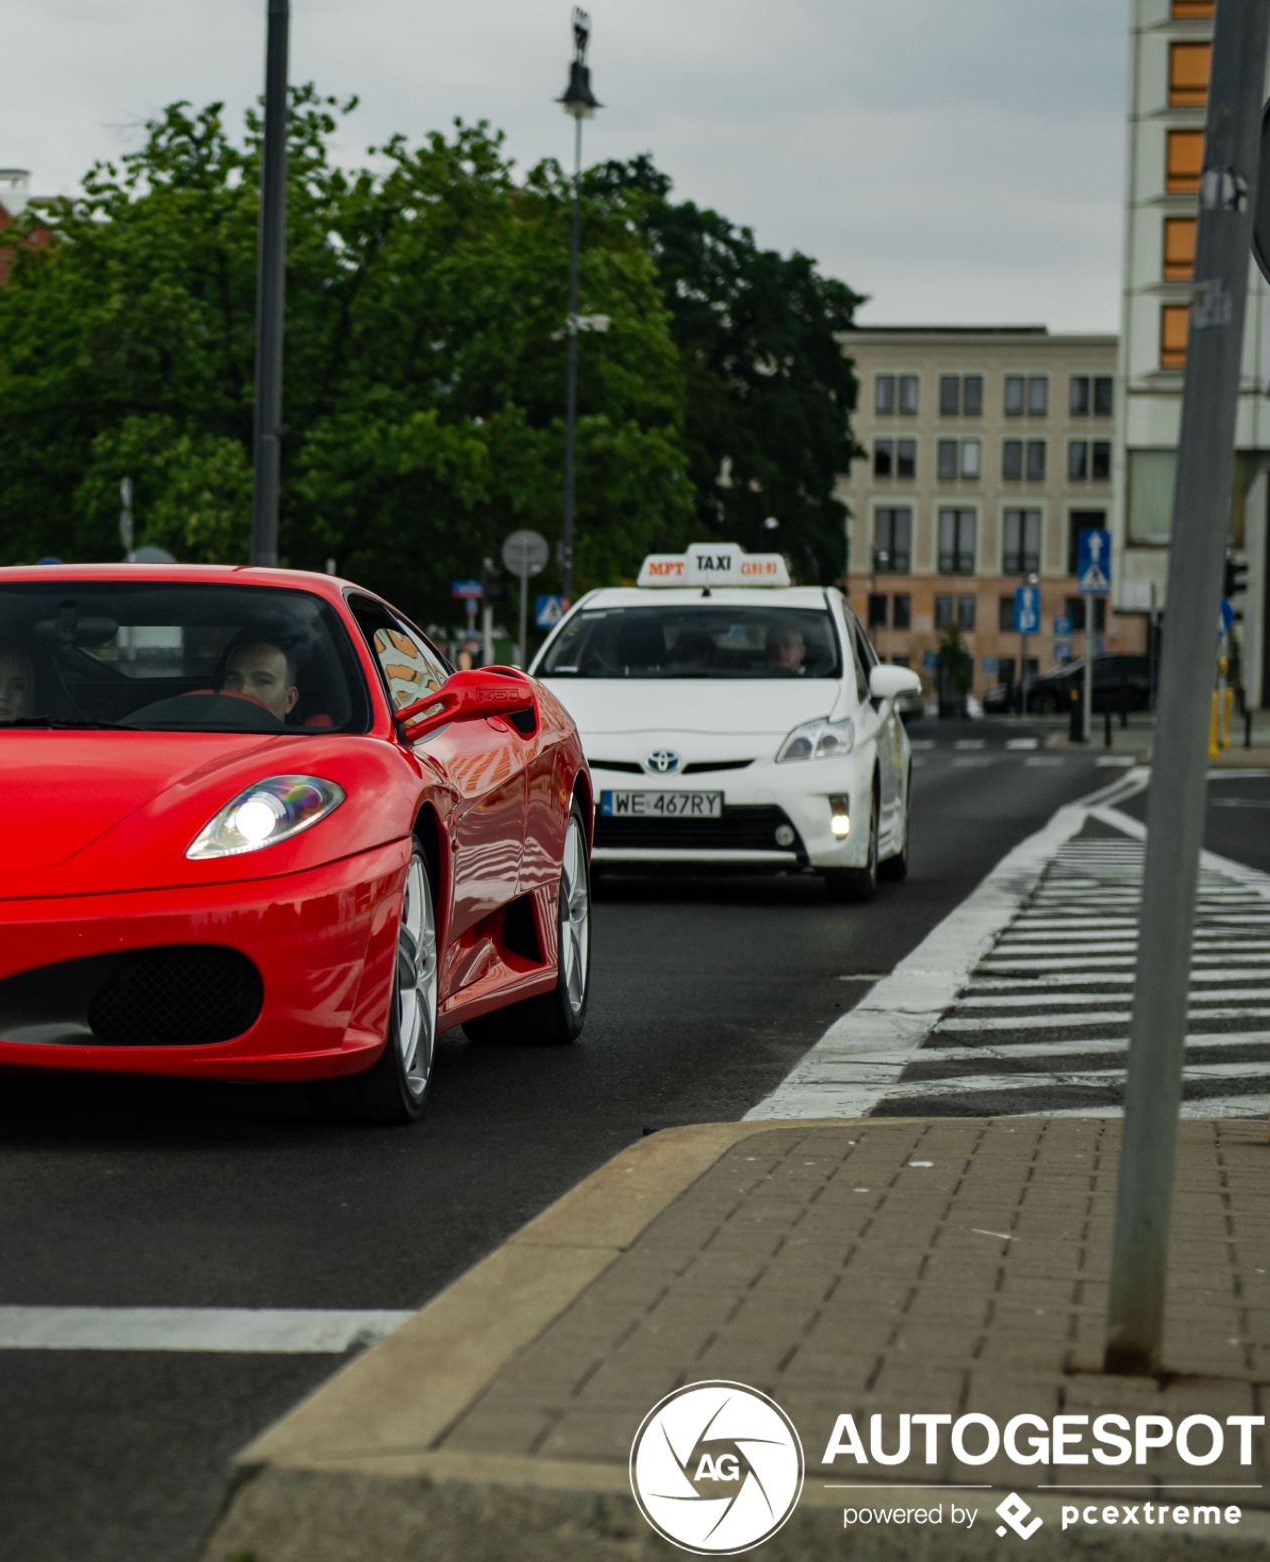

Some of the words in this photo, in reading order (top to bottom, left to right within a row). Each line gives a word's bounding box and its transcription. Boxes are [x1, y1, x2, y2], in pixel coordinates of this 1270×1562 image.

[649, 562, 685, 576] MPT
[696, 555, 731, 571] TAXI
[616, 793, 645, 814] WE
[653, 794, 717, 815] 467RY
